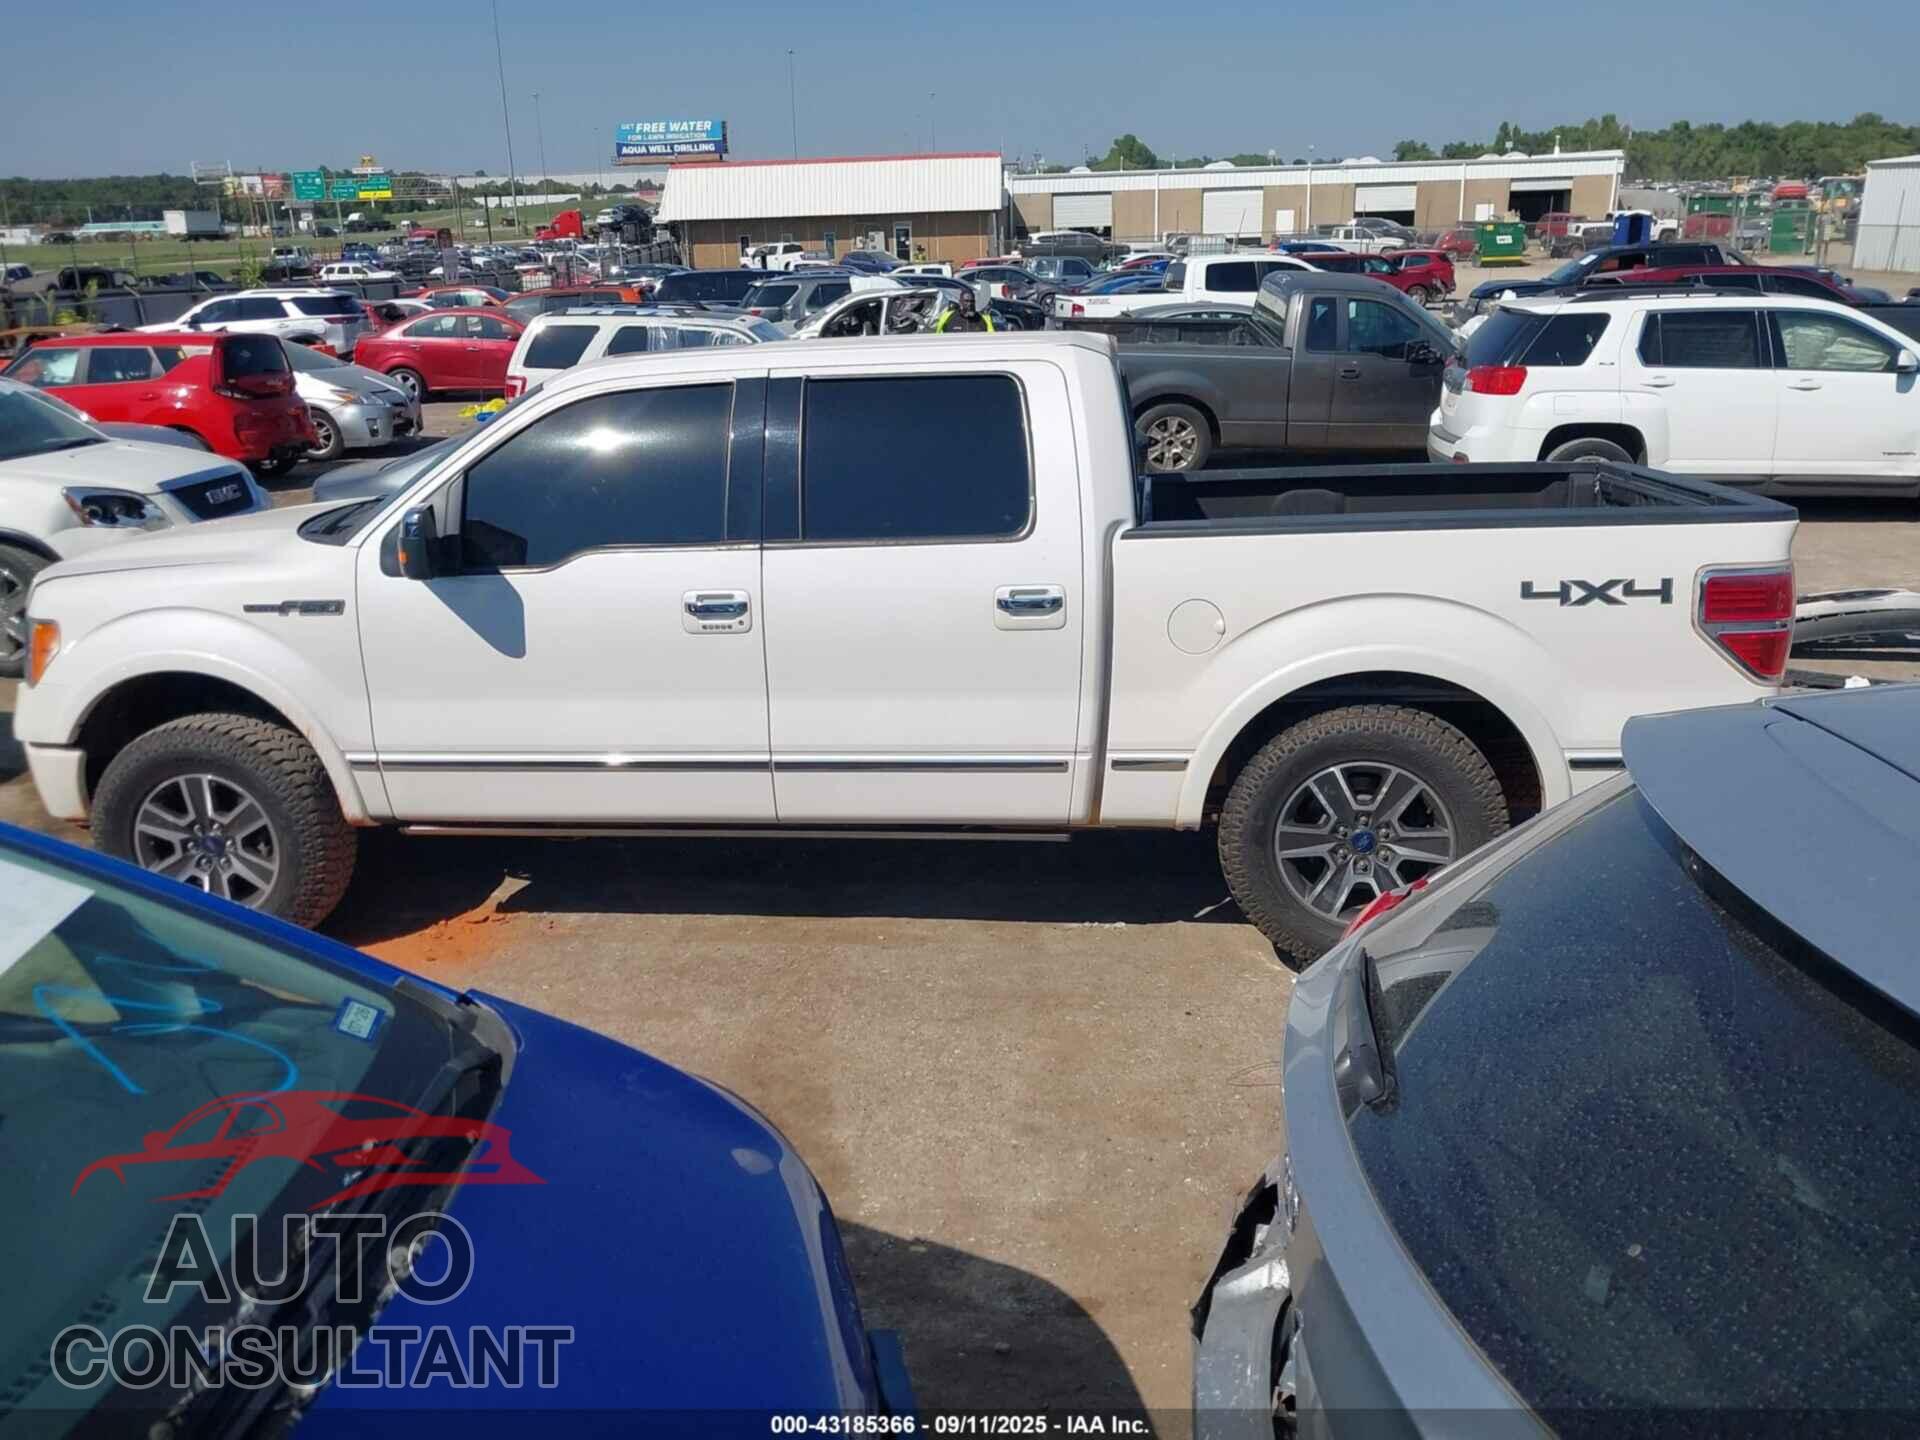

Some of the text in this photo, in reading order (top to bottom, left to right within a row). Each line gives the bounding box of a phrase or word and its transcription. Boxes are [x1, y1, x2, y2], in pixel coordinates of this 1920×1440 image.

[635, 122, 666, 133] FREE
[670, 121, 712, 131] WATER
[622, 144, 715, 154] AQUA WELL DRILLING
